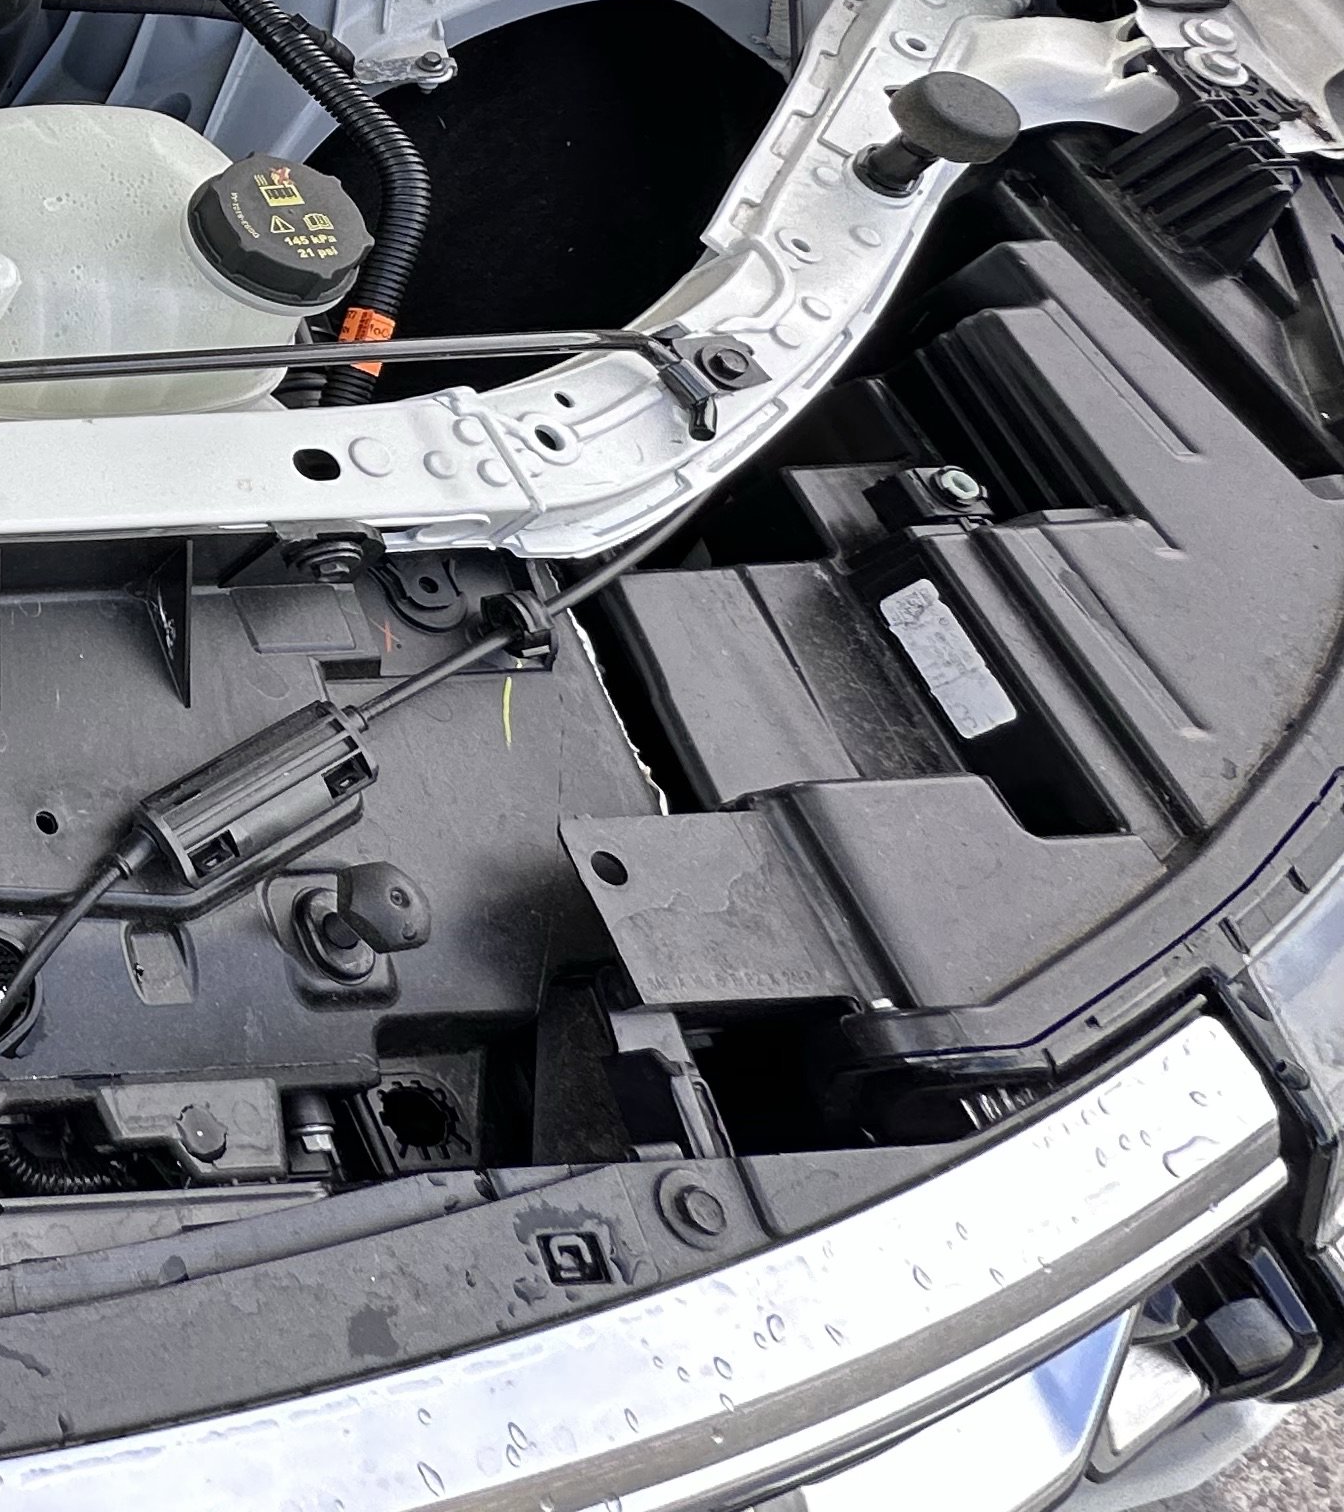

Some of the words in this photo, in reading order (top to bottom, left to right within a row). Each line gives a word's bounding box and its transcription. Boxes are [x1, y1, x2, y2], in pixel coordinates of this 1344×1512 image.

[284, 235, 309, 246] 145
[310, 234, 337, 244] kPa
[297, 247, 315, 258] 21
[317, 245, 338, 259] psi
